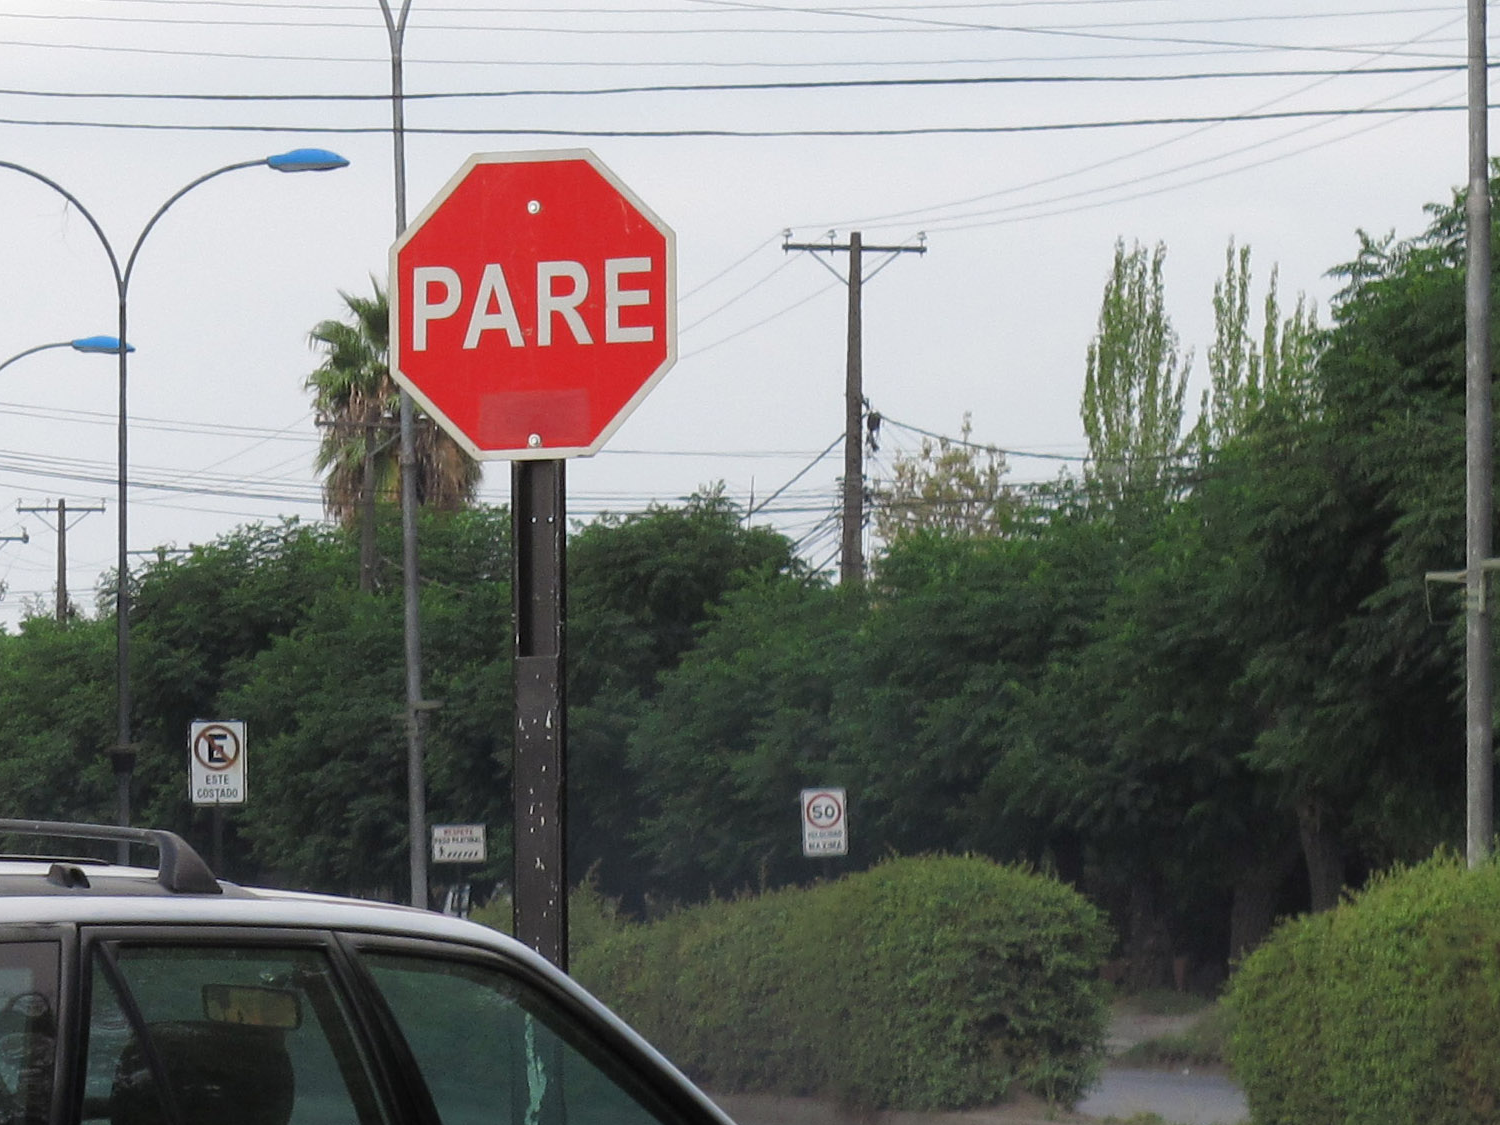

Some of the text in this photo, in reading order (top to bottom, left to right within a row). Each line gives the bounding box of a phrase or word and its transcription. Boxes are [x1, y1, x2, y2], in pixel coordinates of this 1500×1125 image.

[412, 256, 654, 352] PARE
[205, 774, 229, 785] ESTE
[196, 788, 238, 799] COSTADO
[812, 804, 835, 819] 50
